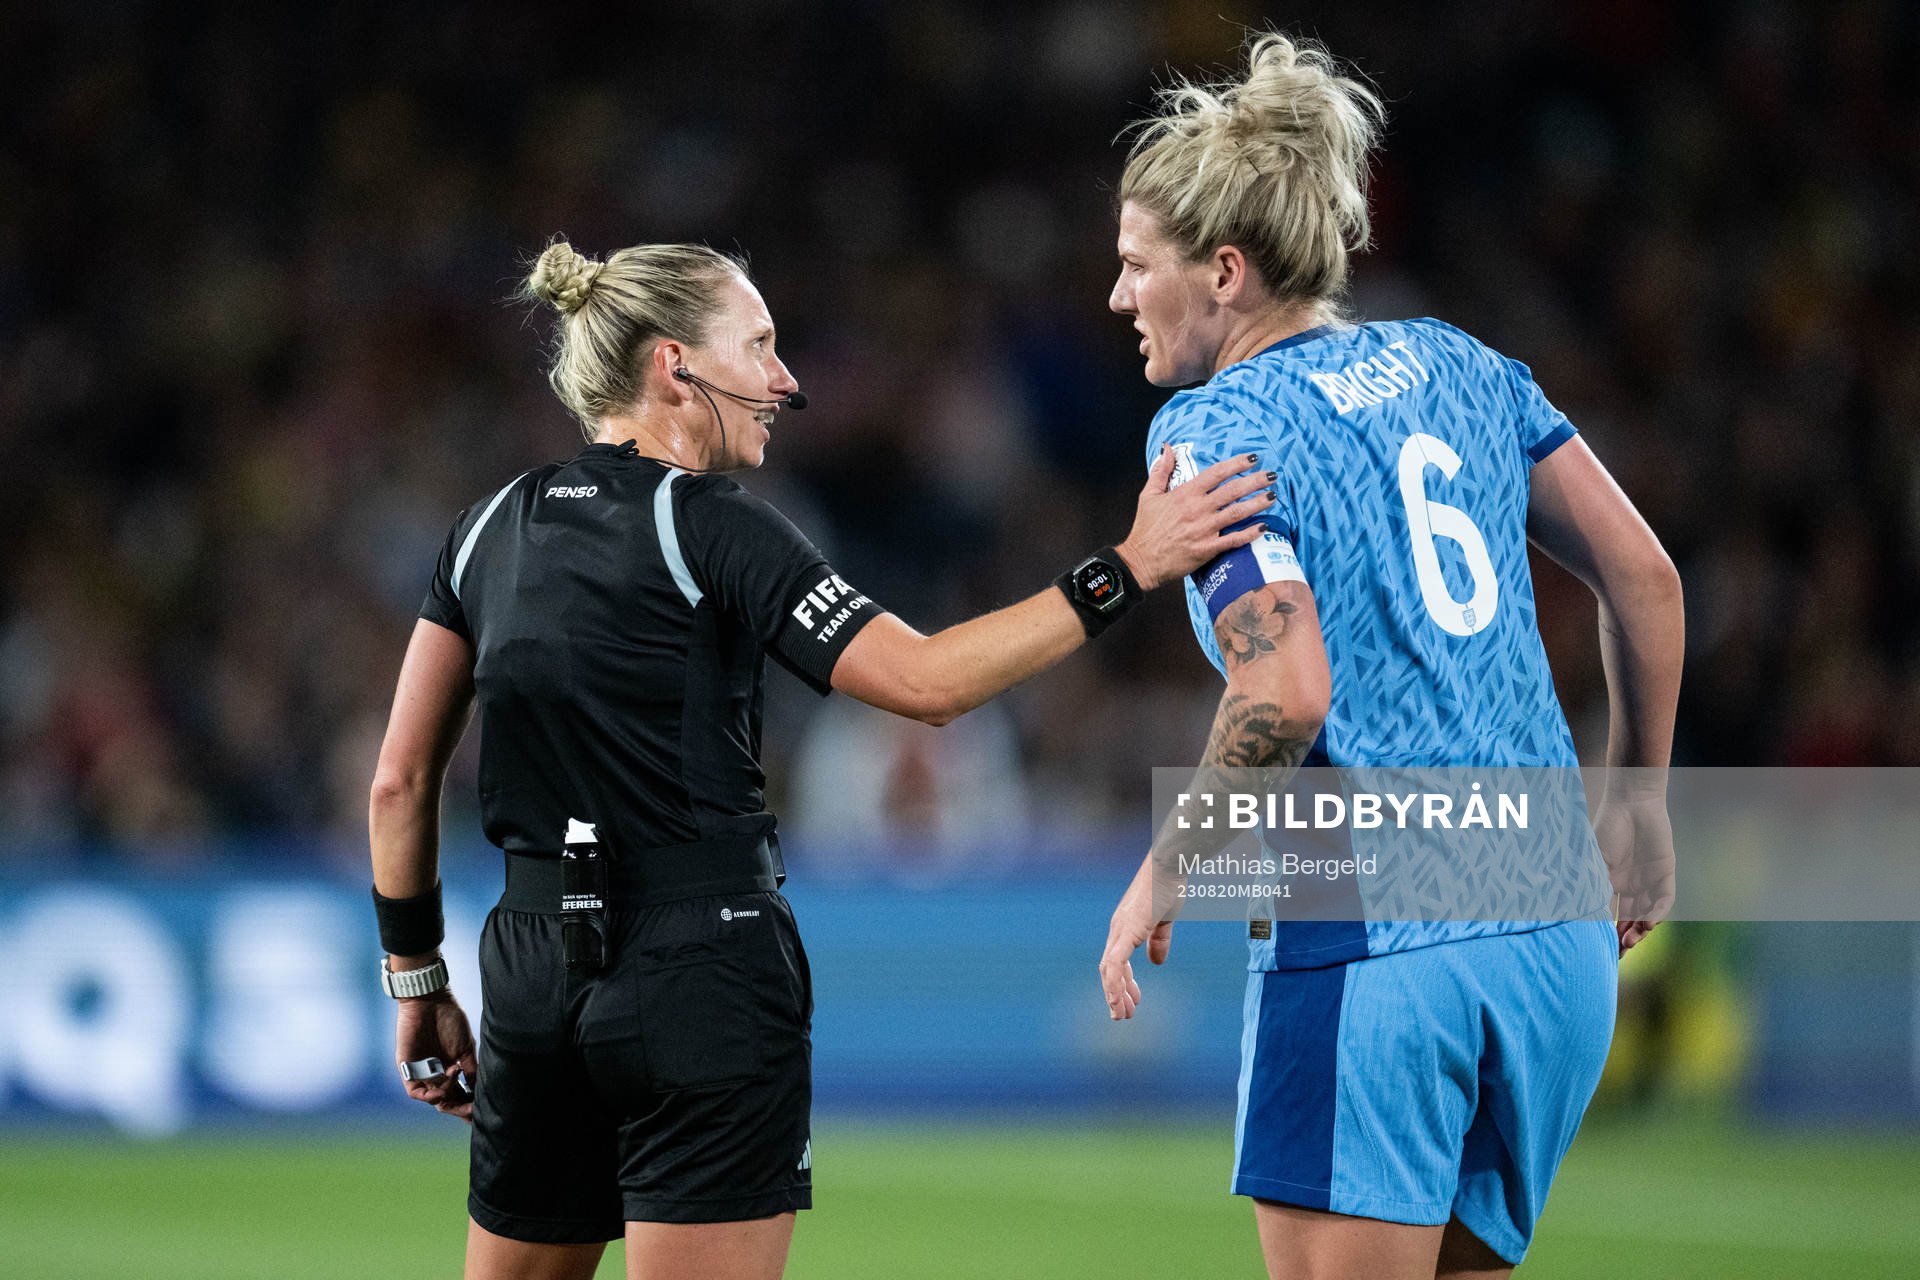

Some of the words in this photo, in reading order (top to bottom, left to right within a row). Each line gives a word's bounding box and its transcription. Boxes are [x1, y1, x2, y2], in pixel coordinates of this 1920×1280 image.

[1309, 340, 1430, 416] BRIGHT
[545, 486, 598, 498] PENSO
[1398, 432, 1499, 637] 6
[1209, 560, 1233, 584] HOPE
[792, 574, 857, 631] FIFA
[817, 607, 853, 643] TEAM
